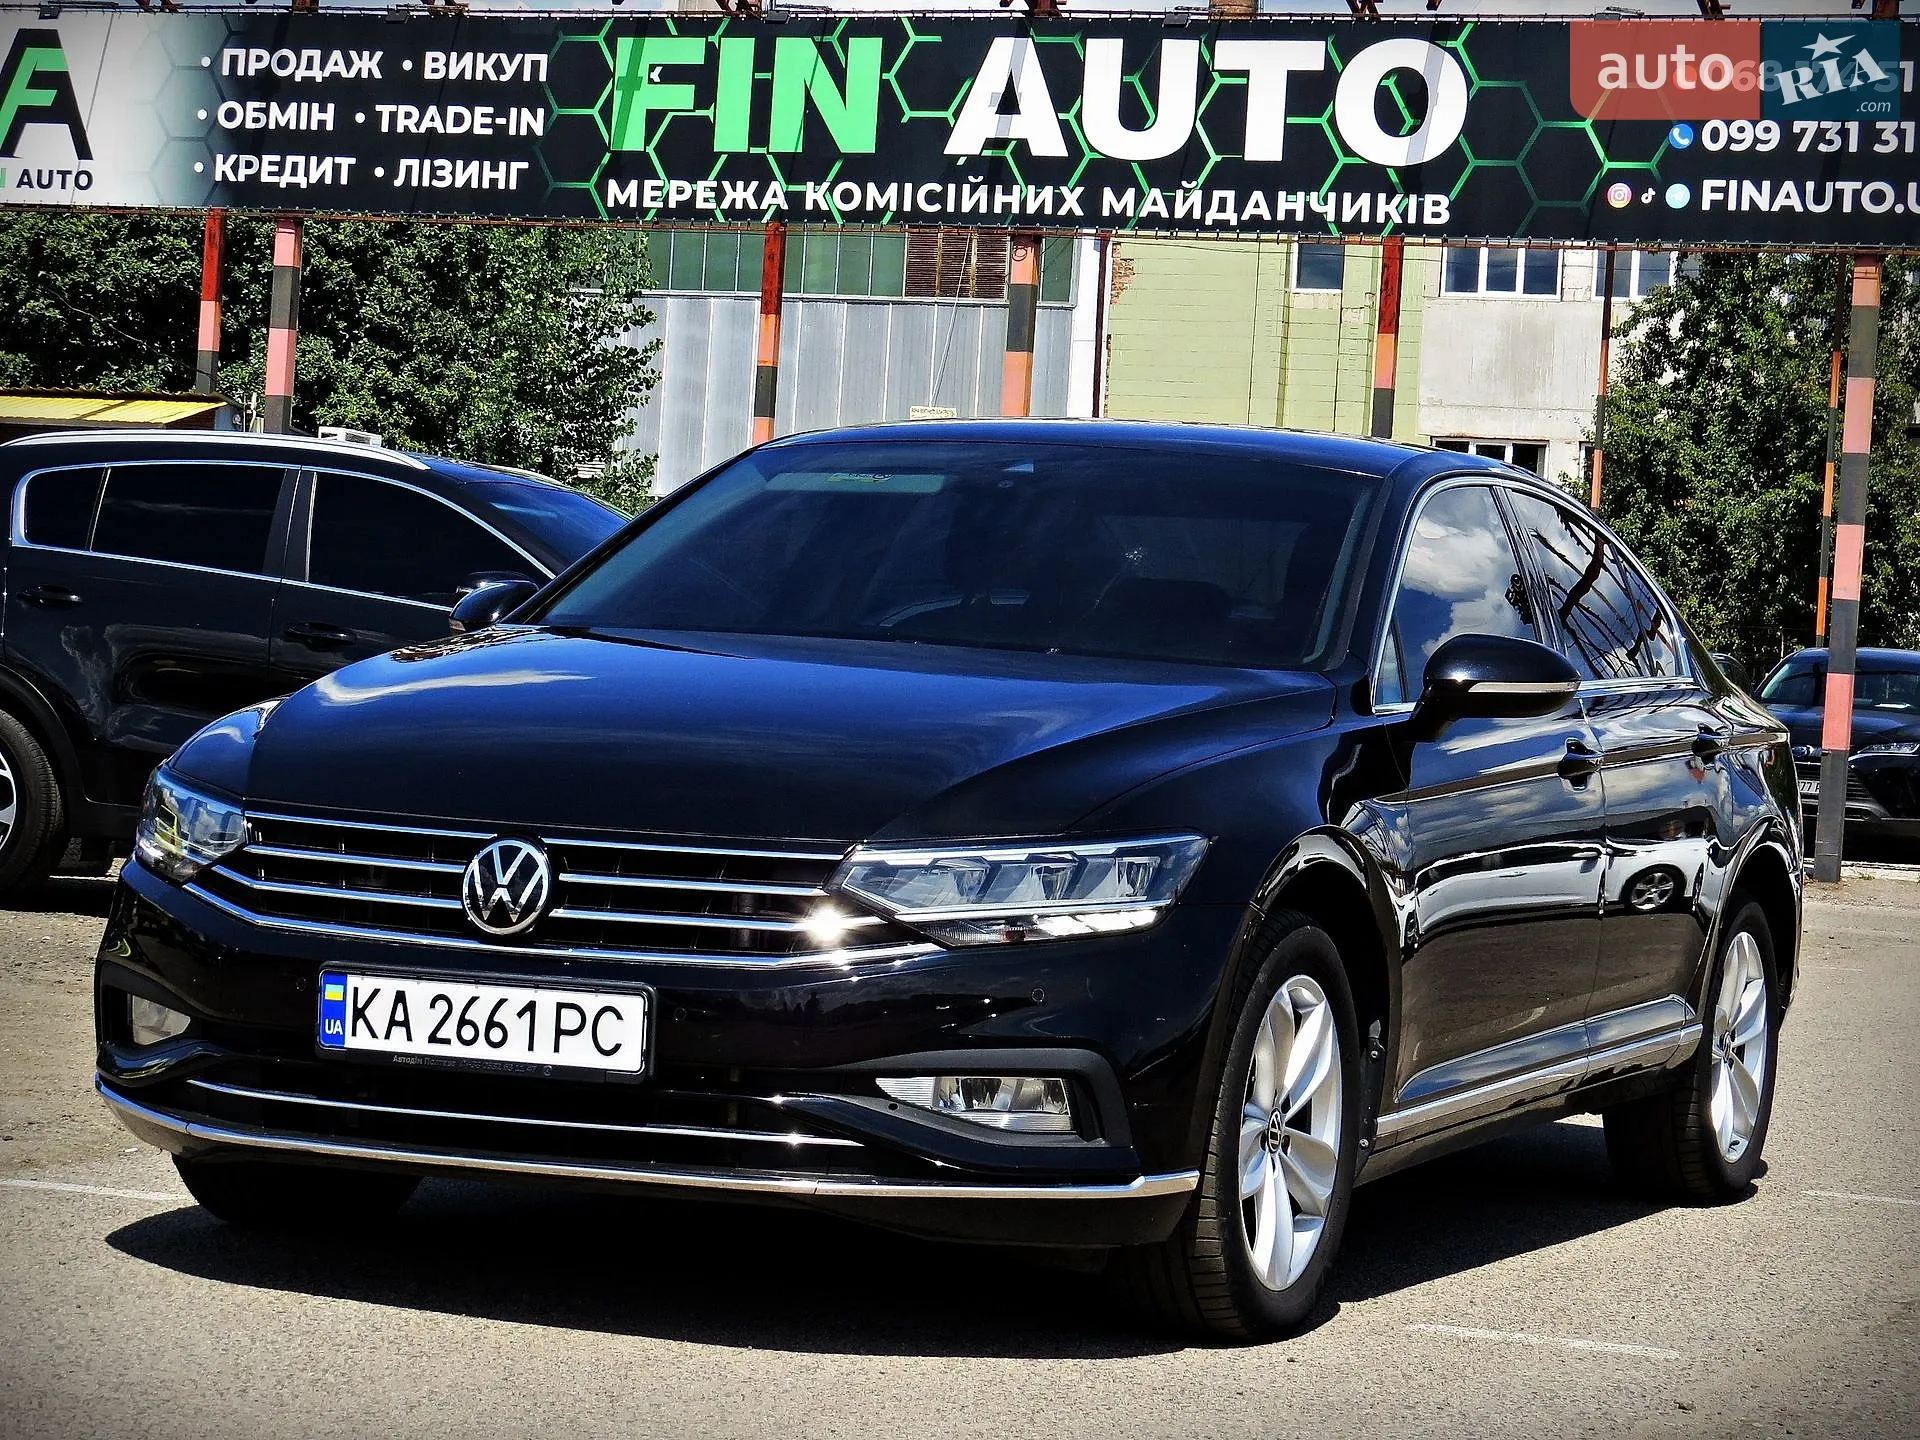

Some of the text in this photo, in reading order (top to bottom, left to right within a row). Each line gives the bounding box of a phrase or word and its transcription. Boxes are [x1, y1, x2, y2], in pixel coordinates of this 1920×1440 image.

[220, 48, 549, 83] ПРОДАЖ ВИКУП
[216, 100, 545, 136] ОБМІН TRADE-IN
[611, 36, 1468, 167] FIN AUTO
[1701, 120, 1914, 154] 099 731 31
[16, 168, 94, 191] AUTO
[214, 154, 529, 191] КРЕДИТ ЛІЗИНГ
[606, 176, 1451, 226] МЕРЕЖА КОМІСІЙНИХ МАЙДАНЧИКІВ
[325, 1018, 343, 1035] UA
[351, 986, 624, 1057] KA 2661 PC
